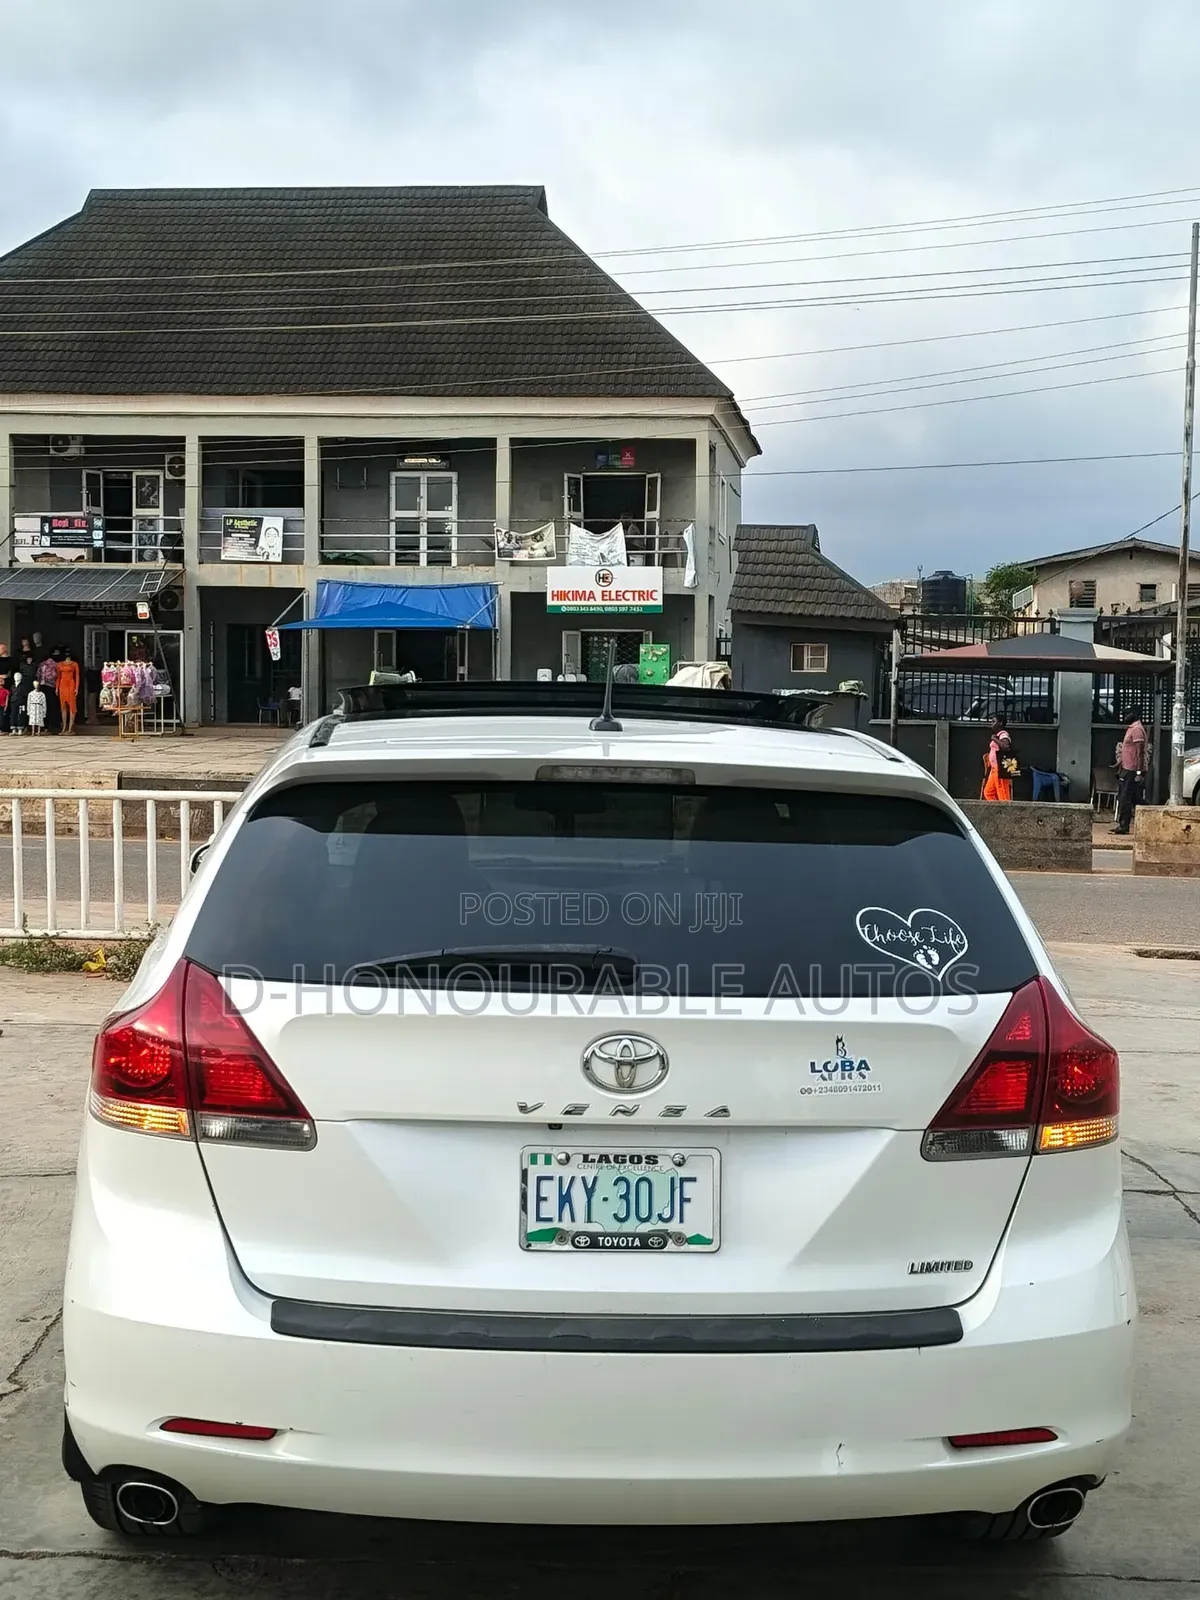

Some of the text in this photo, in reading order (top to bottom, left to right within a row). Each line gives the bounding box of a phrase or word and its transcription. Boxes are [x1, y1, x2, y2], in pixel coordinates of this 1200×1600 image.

[551, 589, 658, 602] HIKIMA ELECTRIC
[860, 923, 967, 955] Choose Life
[809, 1059, 871, 1073] LOBA
[516, 1101, 732, 1118] VENZA
[582, 1153, 659, 1165] LAGOS
[576, 1163, 604, 1171] CENTRE
[619, 1164, 664, 1172] EXCELLENCE
[597, 1236, 641, 1247] TOYOTA
[907, 1259, 974, 1275] LIMITED
